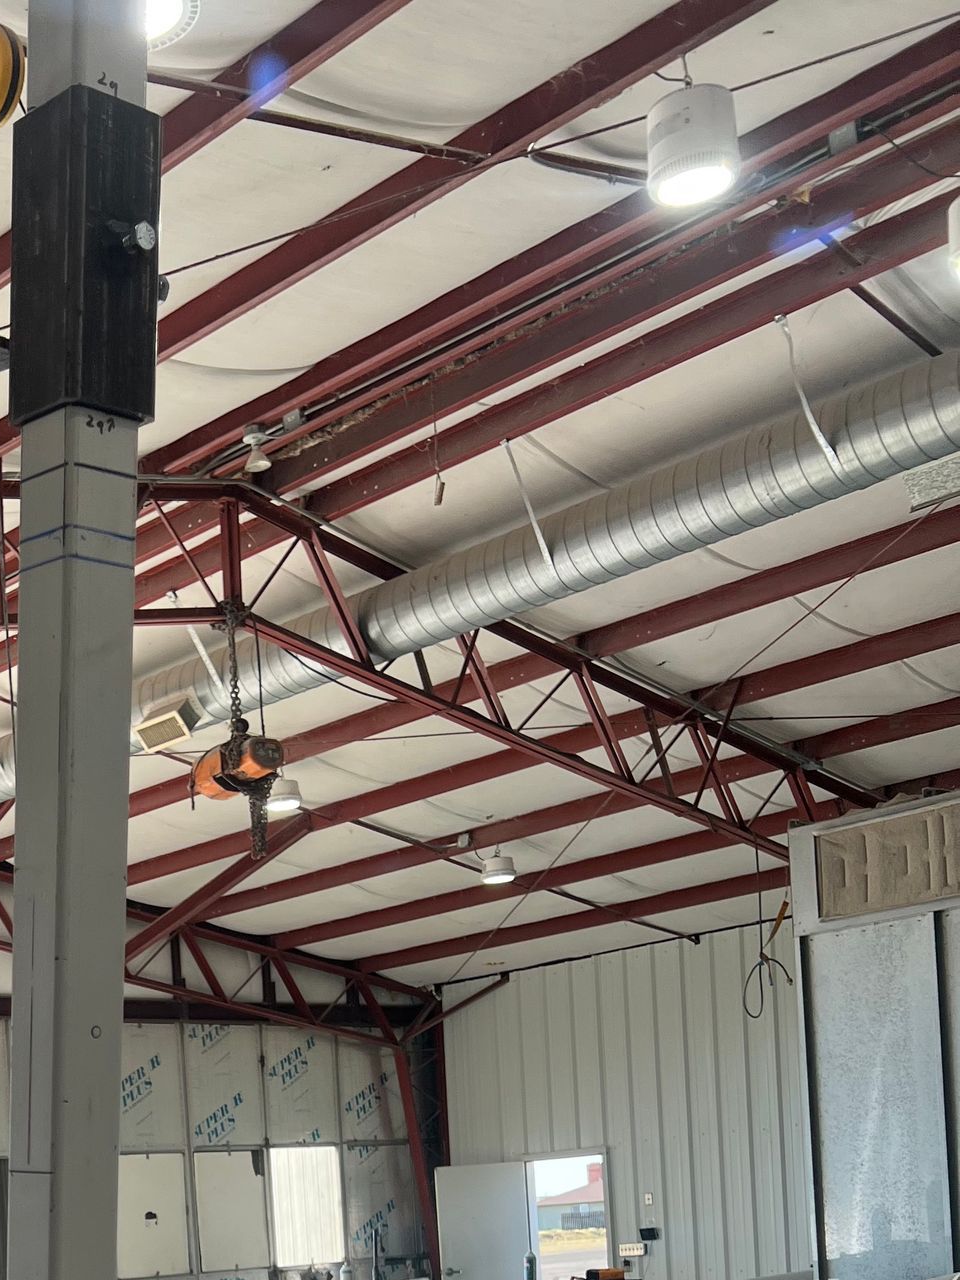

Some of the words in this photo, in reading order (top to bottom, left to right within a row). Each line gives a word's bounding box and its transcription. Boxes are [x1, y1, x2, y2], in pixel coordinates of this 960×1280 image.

[268, 1046, 303, 1079] SUPER
[281, 1055, 309, 1085] PLUS
[122, 1077, 153, 1108] PLUS
[344, 1082, 377, 1115] SUPER
[355, 1092, 382, 1121] PLUS
[194, 1103, 230, 1138] SUPER
[207, 1113, 236, 1144] PLUS
